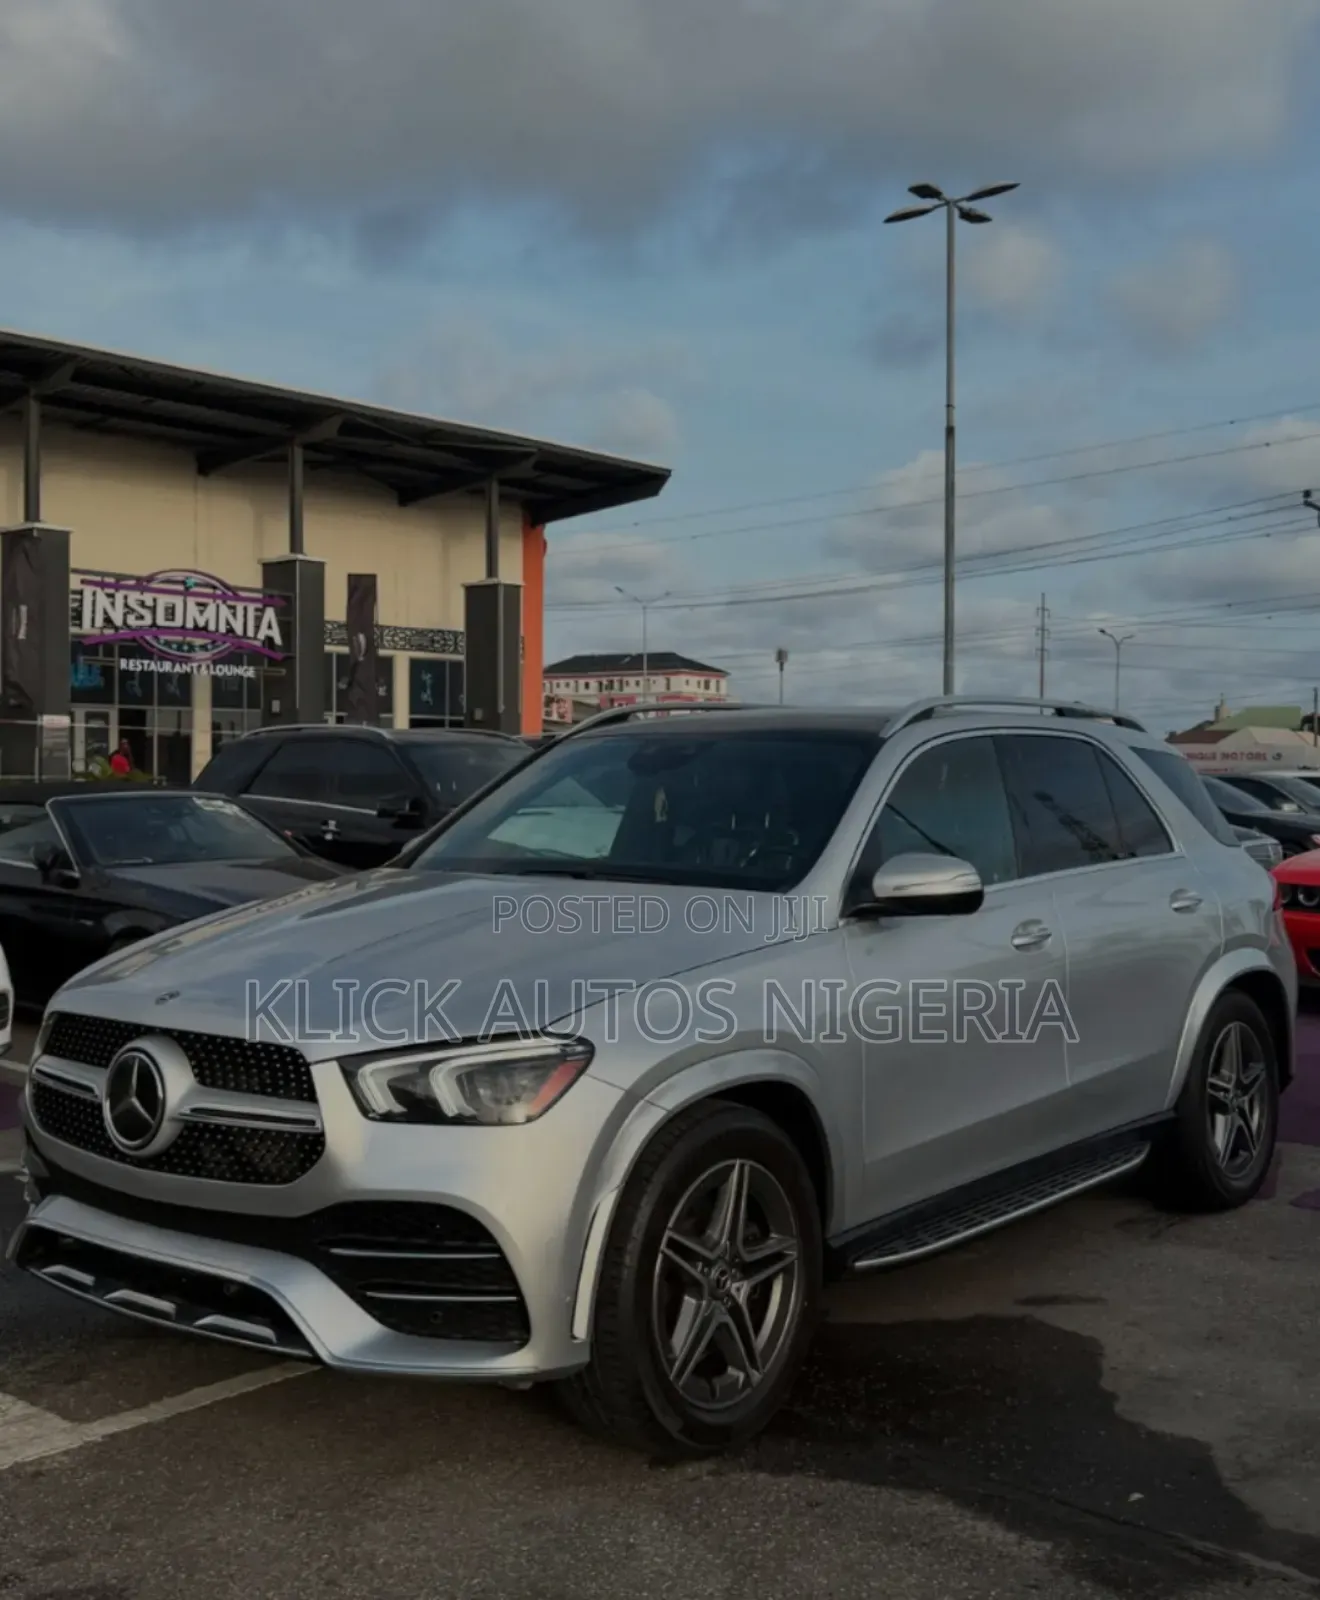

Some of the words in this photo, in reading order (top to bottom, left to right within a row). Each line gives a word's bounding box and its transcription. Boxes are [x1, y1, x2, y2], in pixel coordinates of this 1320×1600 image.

[82, 587, 283, 645] INSOMNIA
[119, 657, 199, 675] RESTAURANT
[209, 664, 256, 679] LOUNGE
